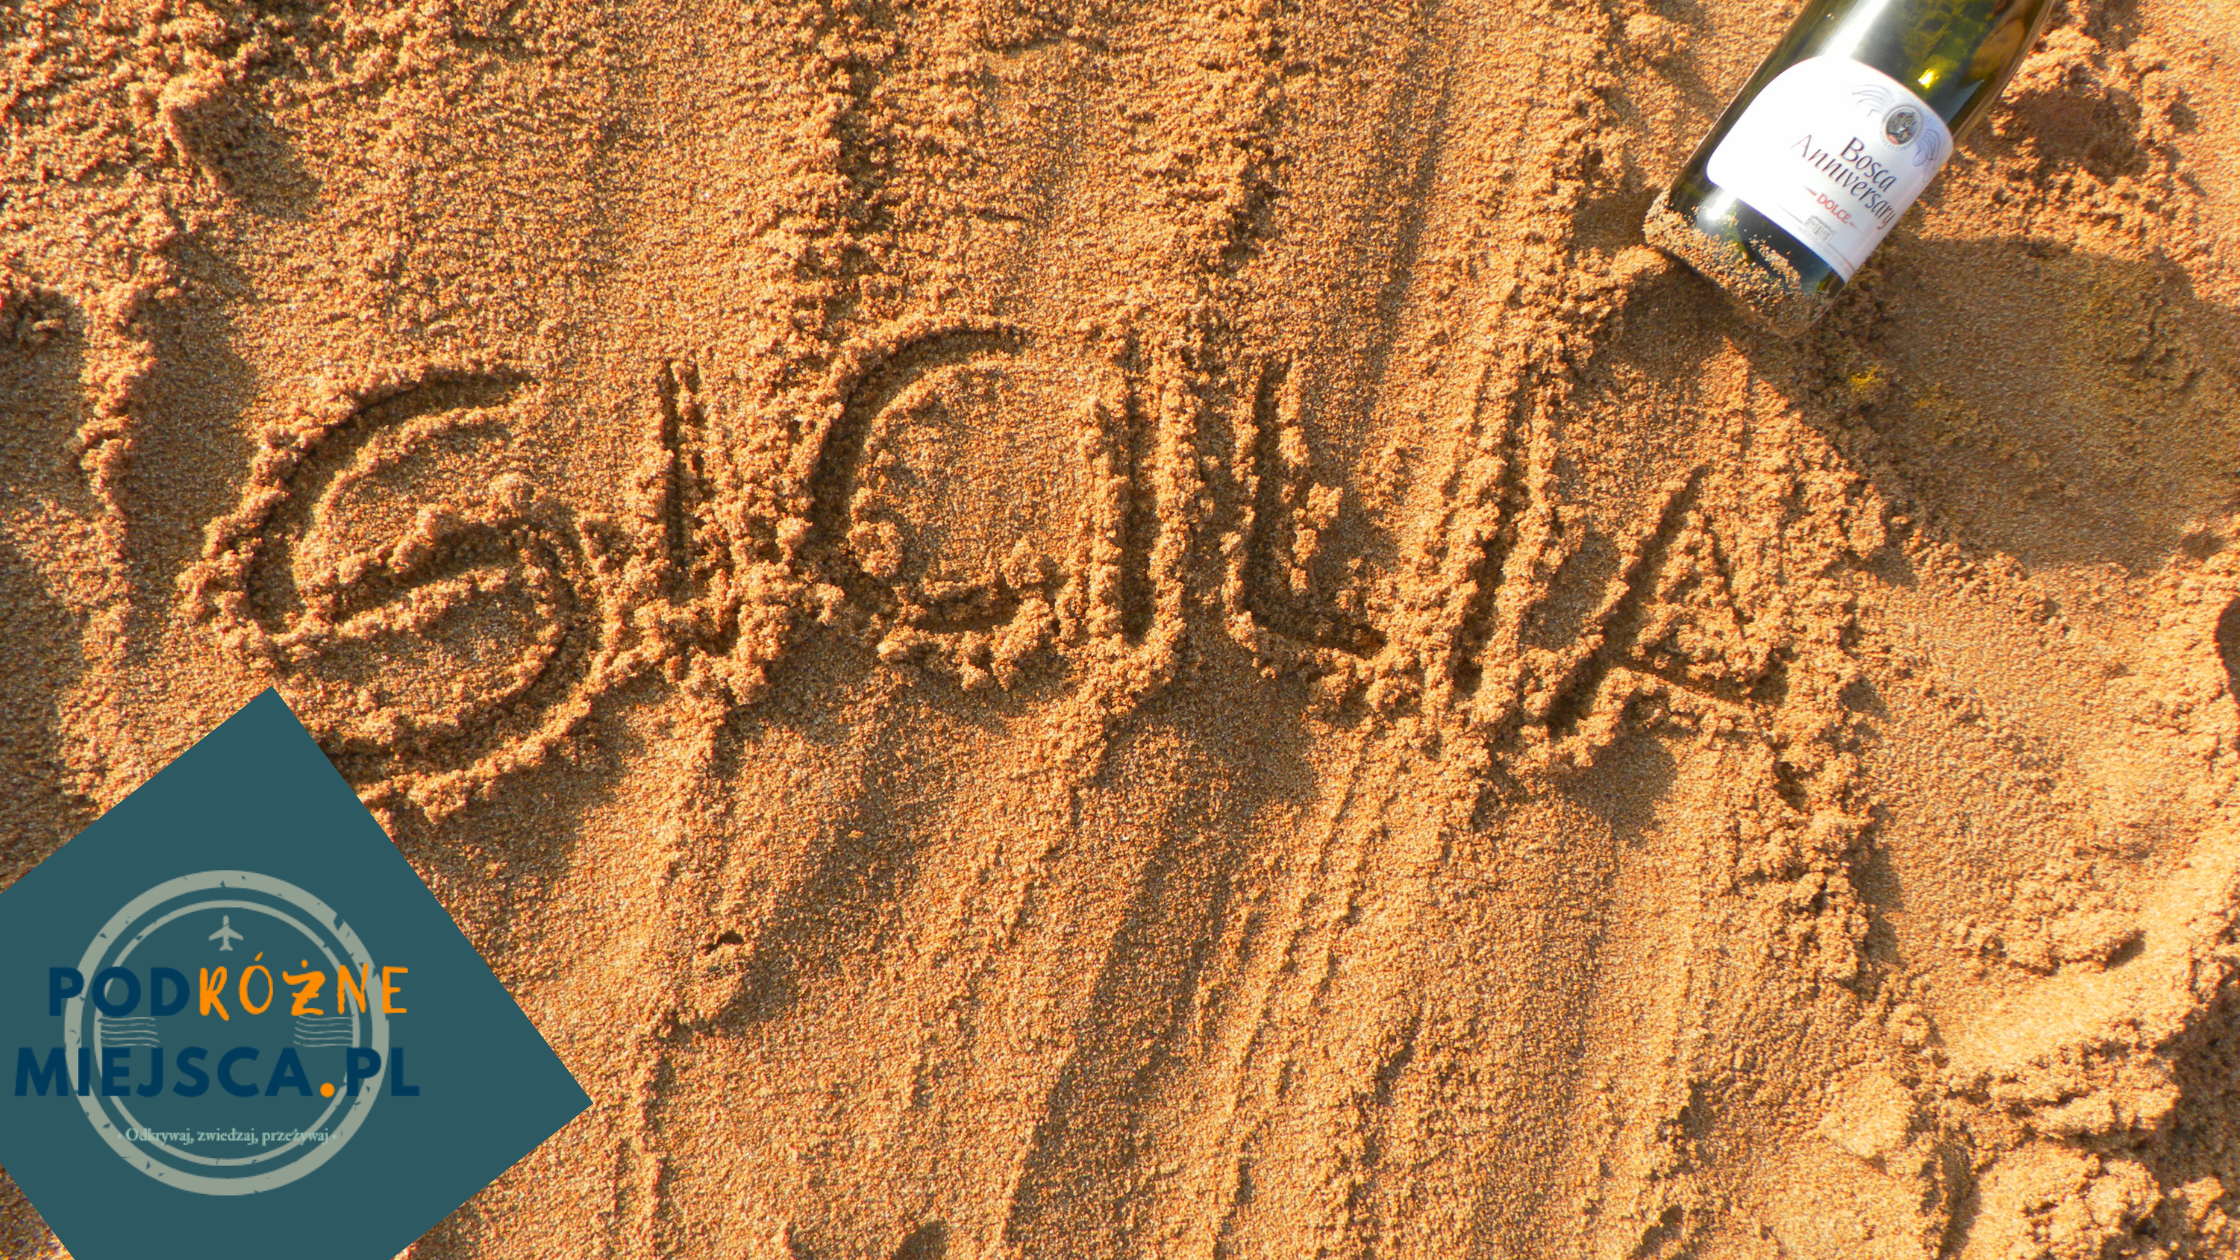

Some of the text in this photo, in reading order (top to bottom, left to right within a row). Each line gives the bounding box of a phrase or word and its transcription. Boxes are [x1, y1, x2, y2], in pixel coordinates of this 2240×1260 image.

[1790, 134, 1896, 230] Anniversary
[1840, 136, 1897, 192] Bosca
[1816, 193, 1852, 224] DOLCE
[220, 325, 1795, 785] SICILIA
